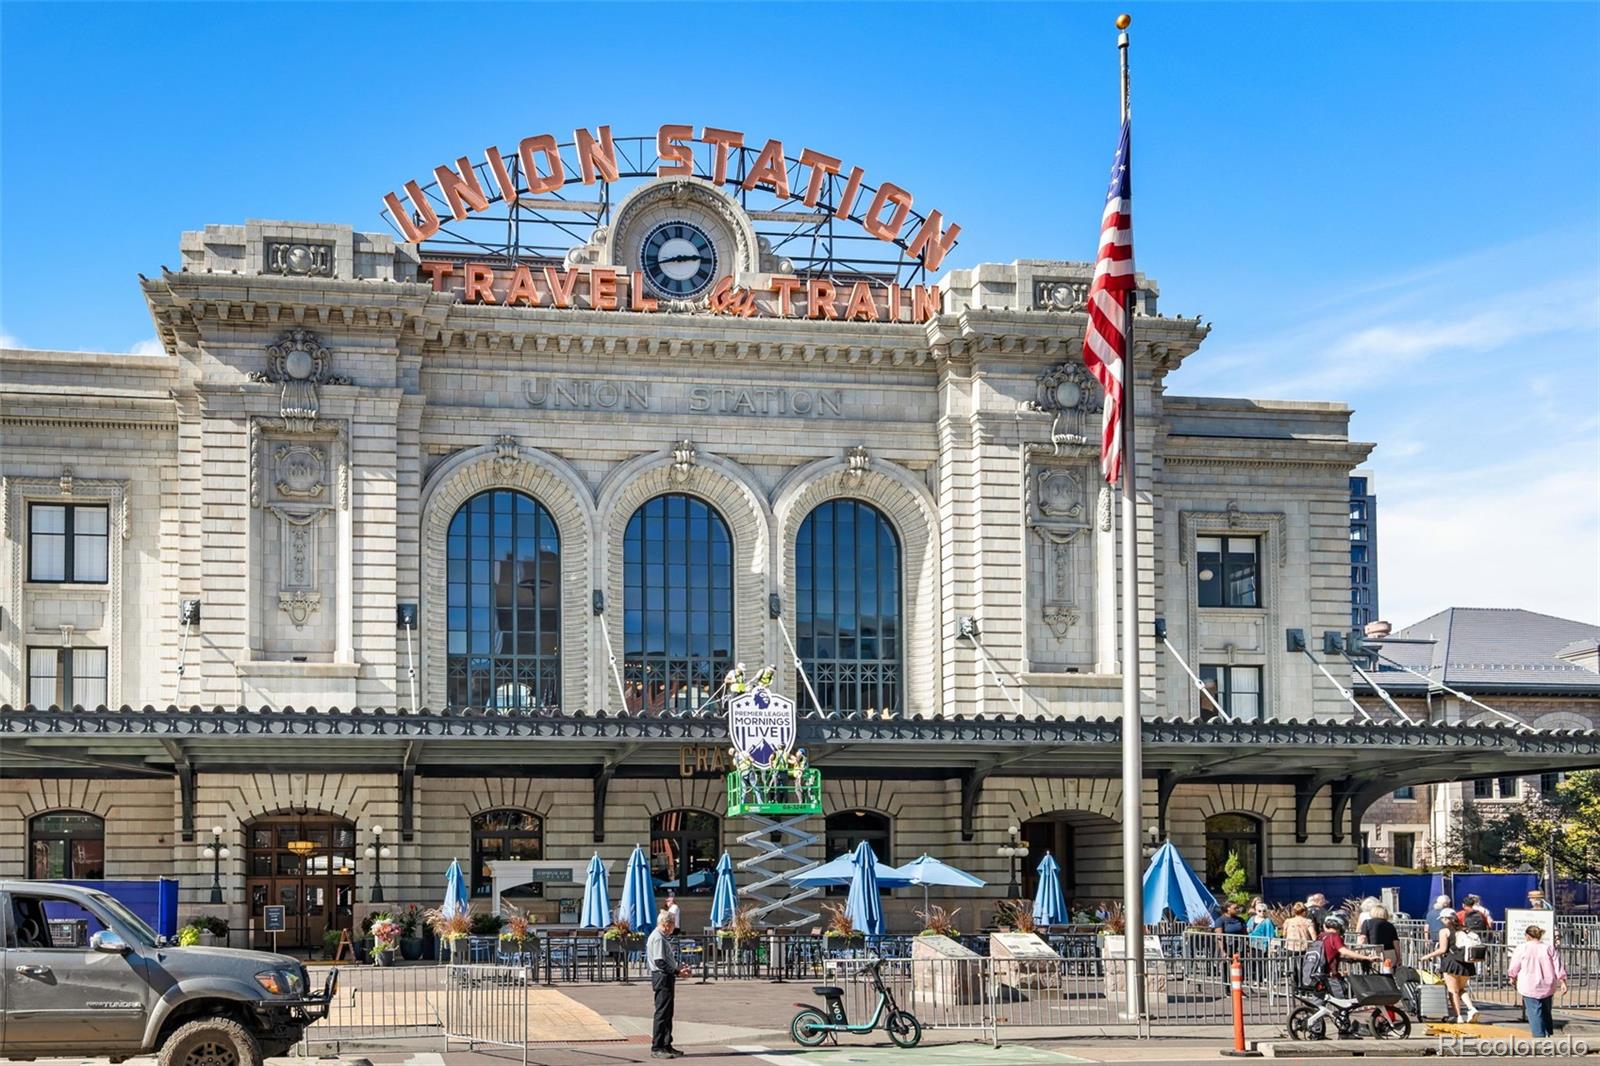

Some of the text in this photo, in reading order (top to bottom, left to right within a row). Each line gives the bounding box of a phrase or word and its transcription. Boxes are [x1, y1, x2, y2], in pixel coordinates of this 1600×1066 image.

[384, 124, 961, 272] UNION STATION
[421, 261, 658, 311] TRAVEL
[769, 277, 941, 322] TRAIN
[522, 379, 843, 416] UNION STATION
[735, 717, 791, 726] MORNINGS
[747, 726, 779, 738] LIVE
[832, 1001, 843, 1020] veo
